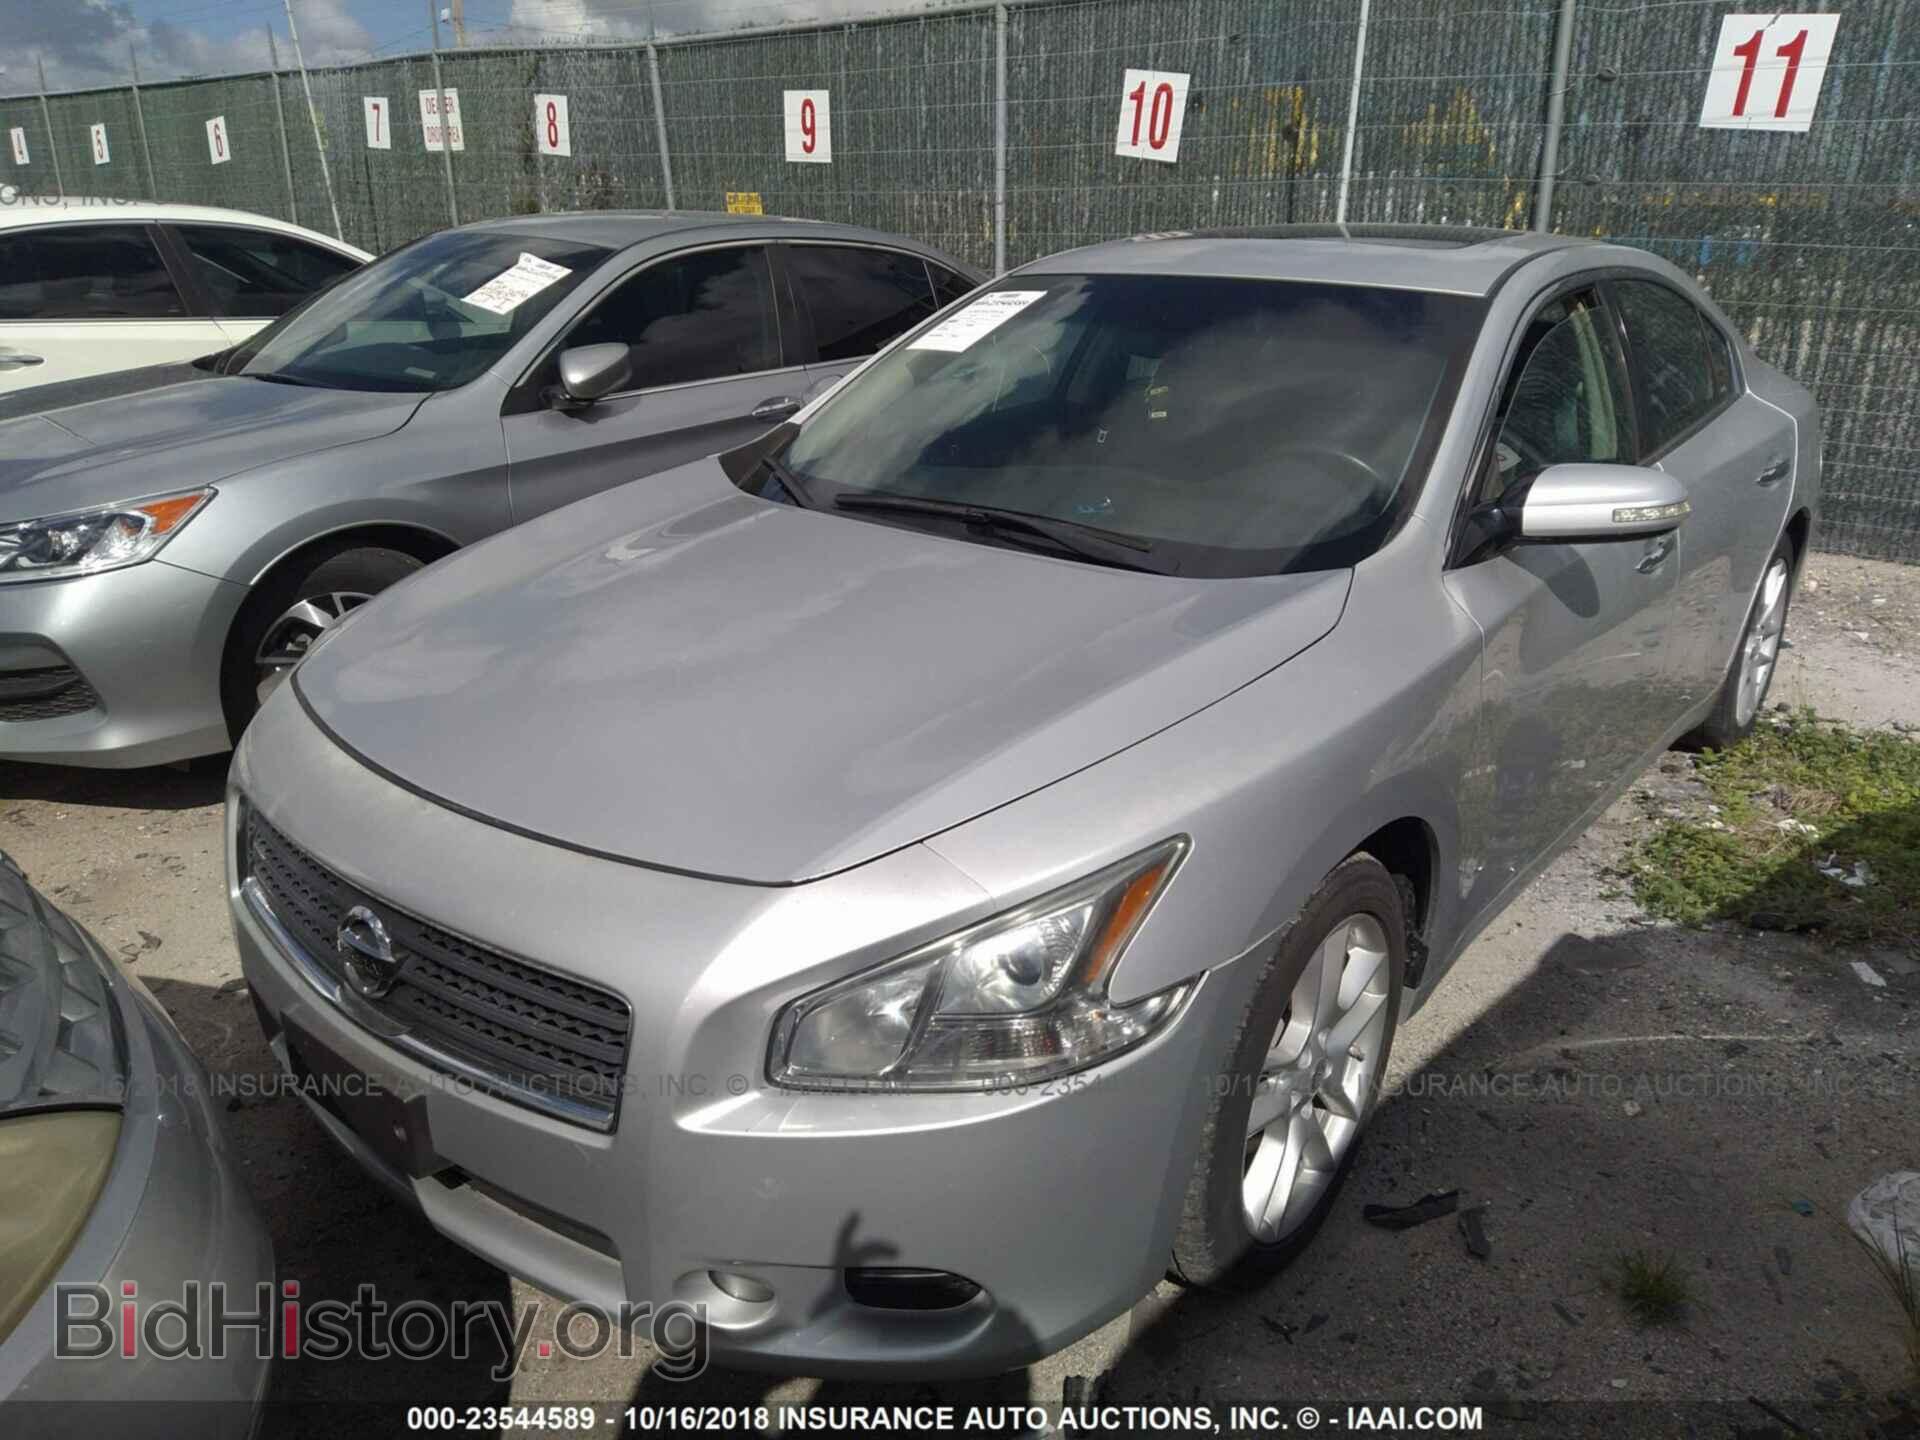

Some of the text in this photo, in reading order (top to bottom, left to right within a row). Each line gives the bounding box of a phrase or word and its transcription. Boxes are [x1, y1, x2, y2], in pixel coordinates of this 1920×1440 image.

[1732, 29, 1809, 118] 11
[371, 103, 382, 142] 7
[425, 95, 455, 114] DEER
[546, 101, 559, 148] 8
[799, 98, 817, 154] 9
[1128, 80, 1174, 150] 10
[94, 129, 105, 160] 5
[213, 123, 225, 158] 6
